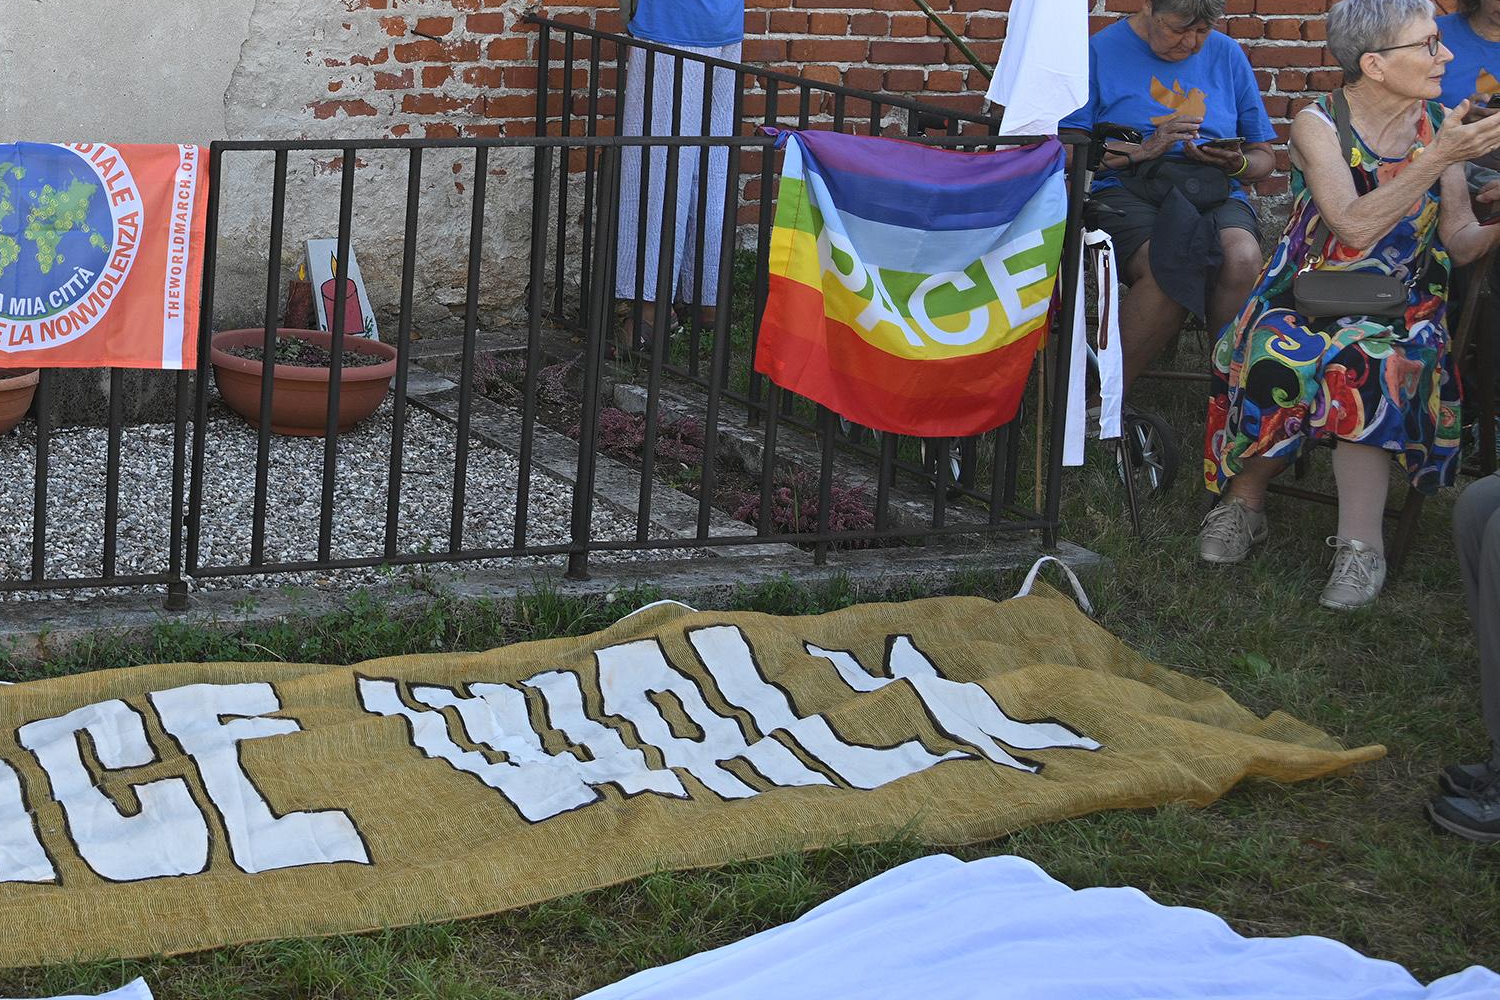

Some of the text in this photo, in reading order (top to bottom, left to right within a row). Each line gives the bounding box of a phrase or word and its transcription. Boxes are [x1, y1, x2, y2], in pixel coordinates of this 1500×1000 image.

[65, 143, 135, 207] DIALE
[8, 324, 34, 347] LA
[39, 211, 139, 342] NONVIOLENZA
[9, 297, 46, 316] MIA
[49, 266, 95, 308] CITTÀ
[816, 229, 1052, 348] PACE
[354, 621, 1104, 825] WALK
